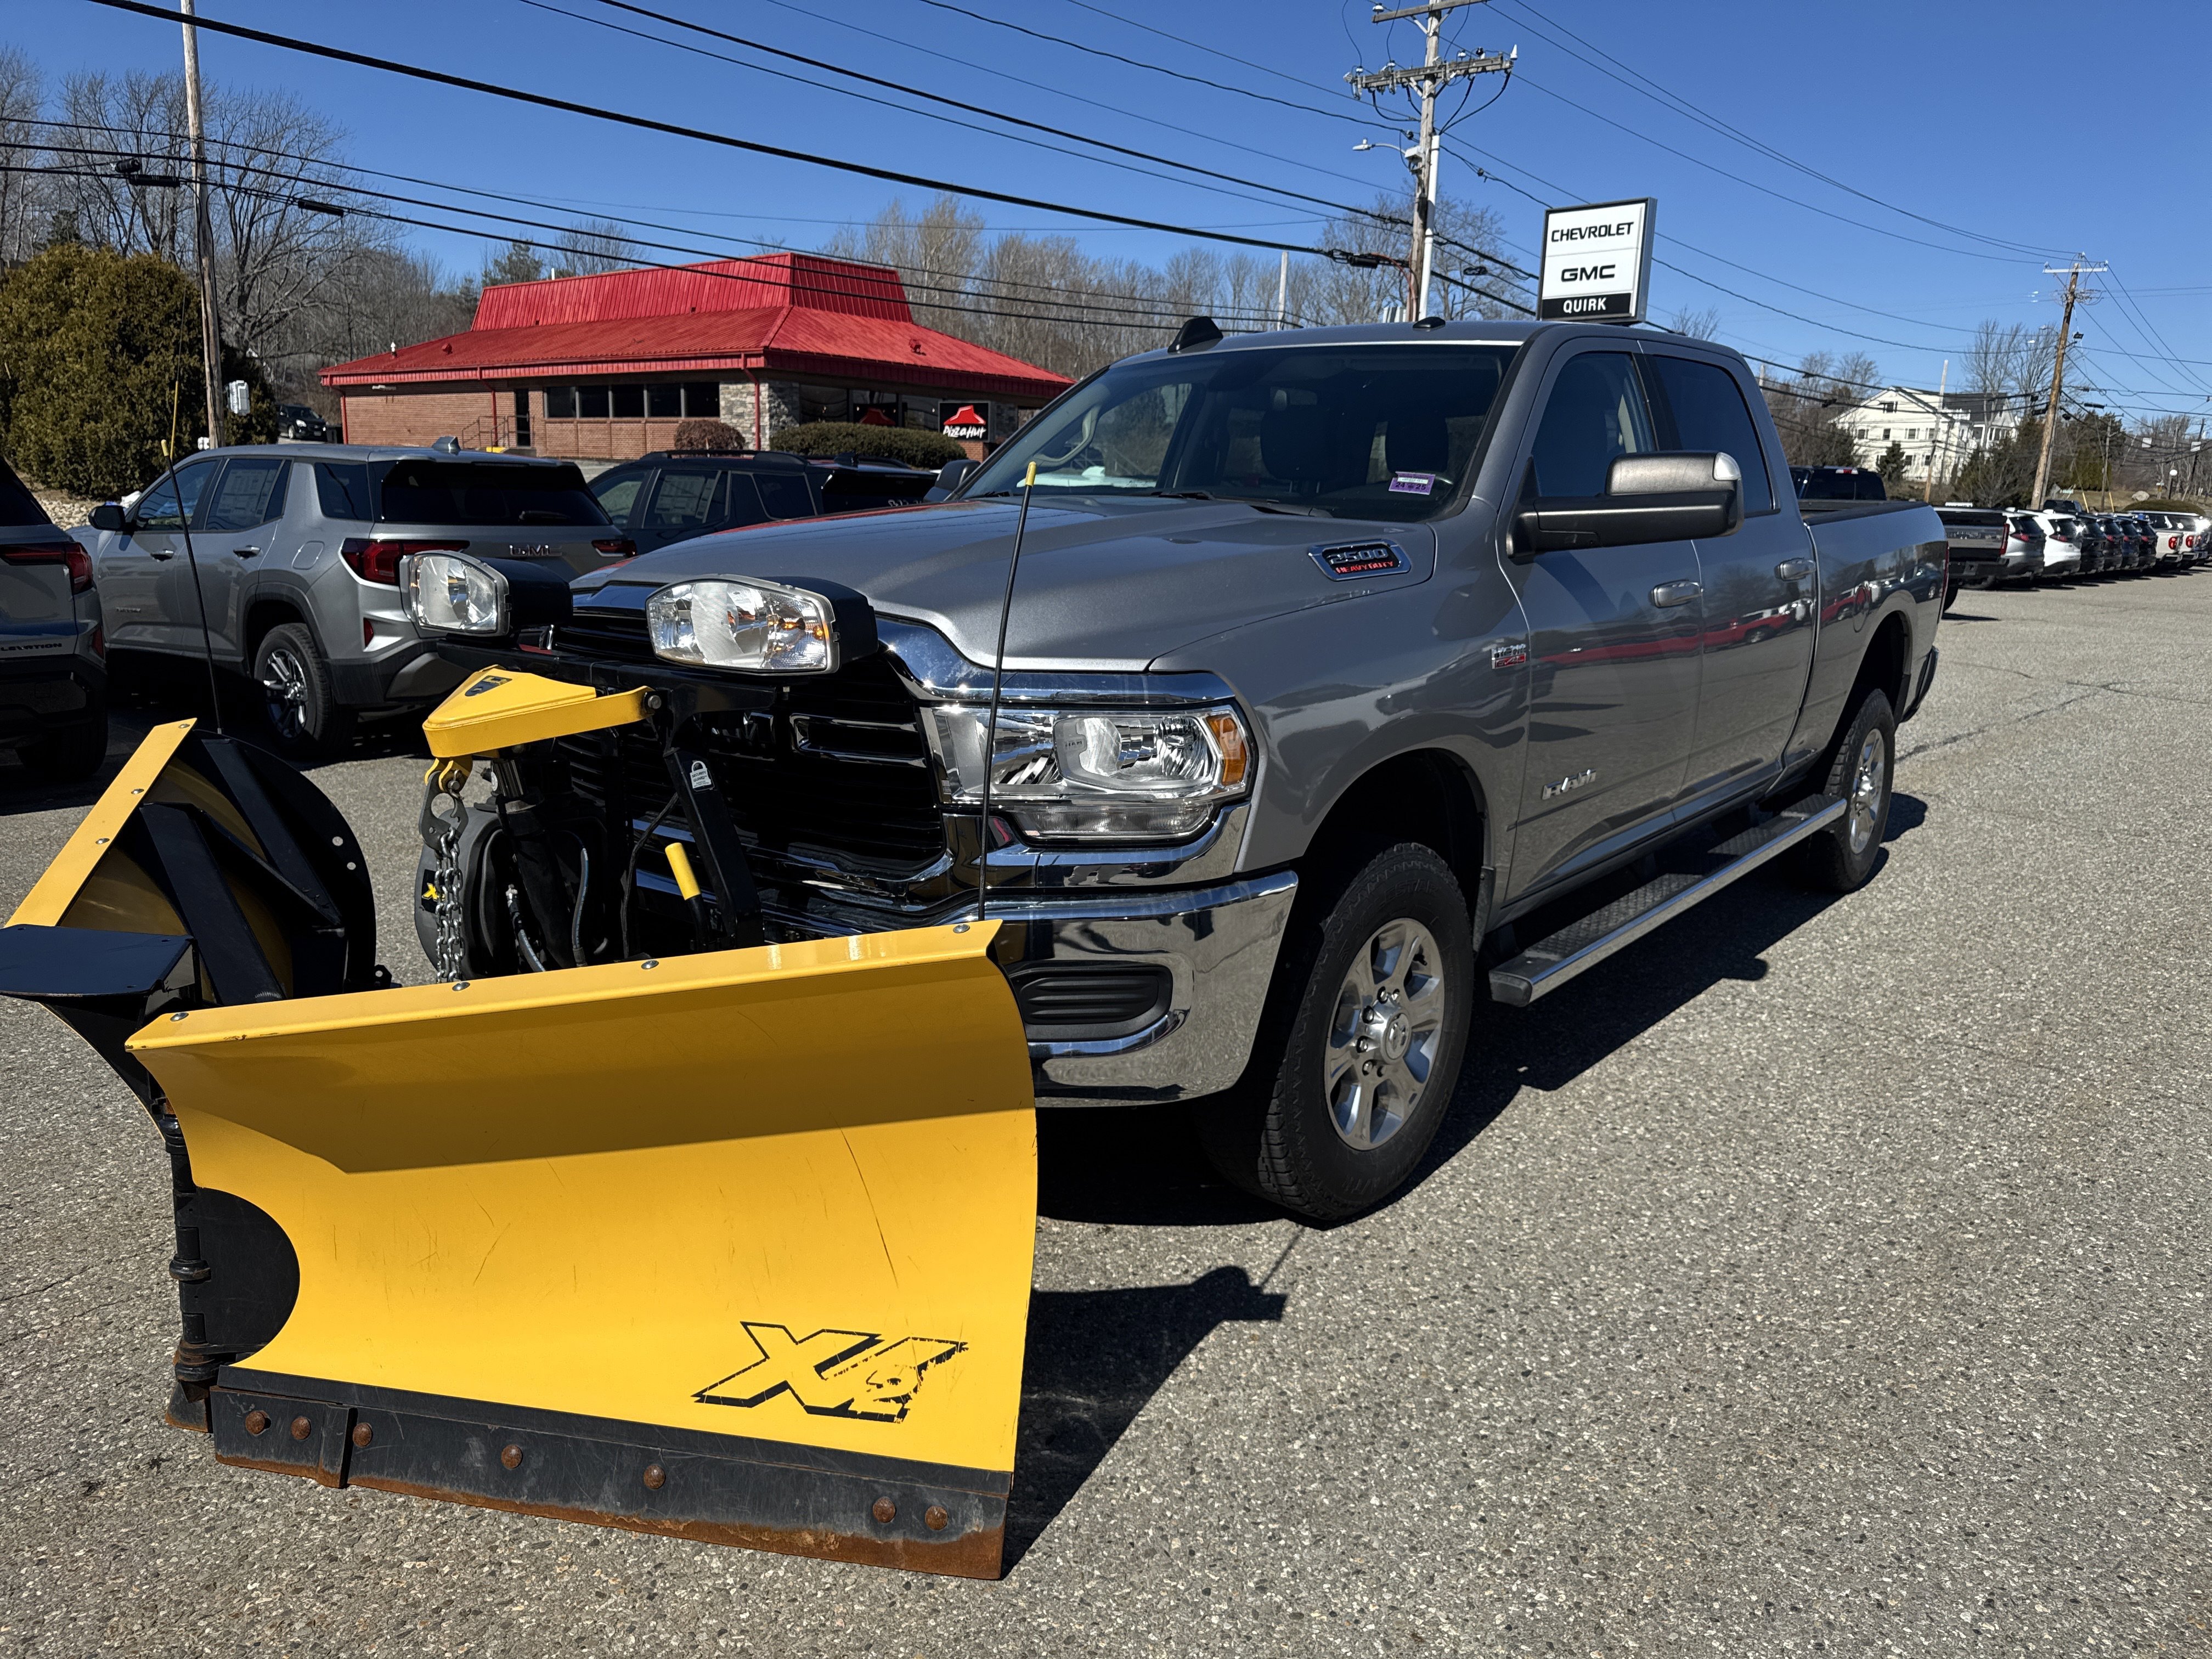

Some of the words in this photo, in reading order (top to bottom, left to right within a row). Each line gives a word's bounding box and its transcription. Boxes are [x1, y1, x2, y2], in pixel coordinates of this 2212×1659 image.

[1551, 222, 1634, 242] CHEVROLET
[1561, 264, 1616, 283] GMC
[1562, 297, 1607, 314] QUIRK
[943, 425, 967, 438] Pizza
[966, 425, 987, 439] Hut
[1327, 548, 1389, 565] 2500
[1335, 564, 1368, 574] HEAVY
[1367, 561, 1395, 571] DUTY
[0, 643, 62, 651] LEVATION
[1542, 769, 1597, 800] RAM
